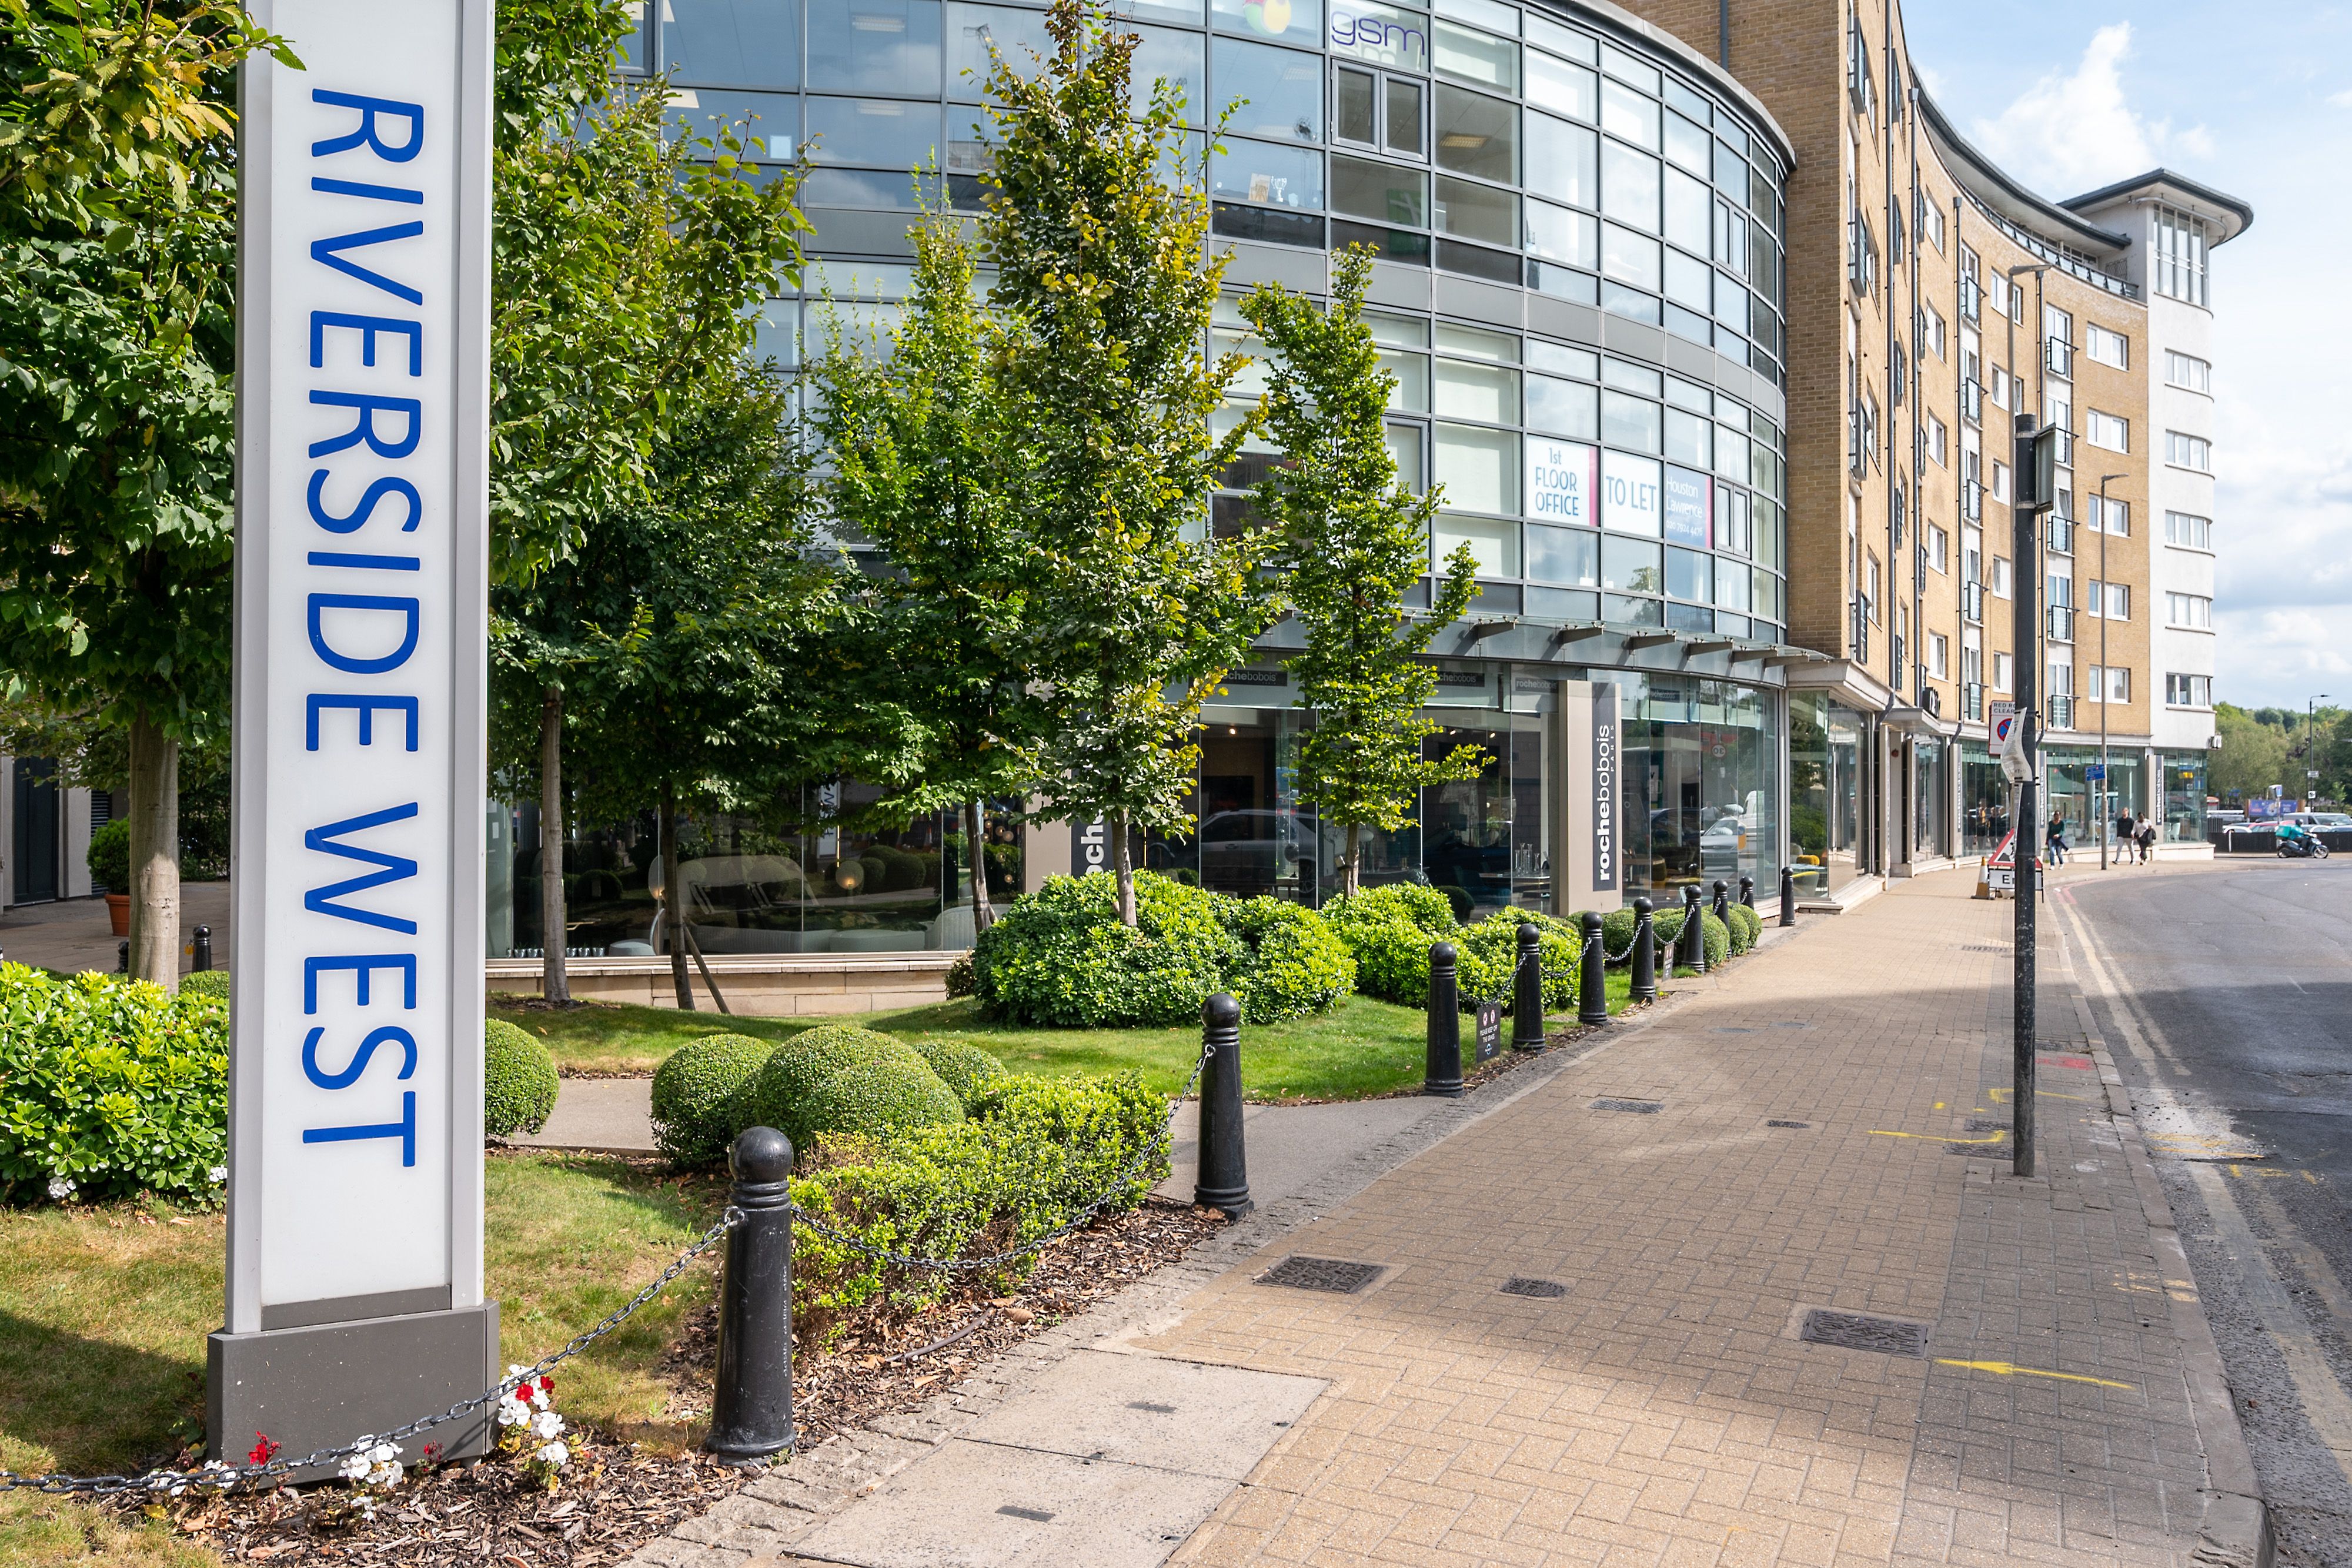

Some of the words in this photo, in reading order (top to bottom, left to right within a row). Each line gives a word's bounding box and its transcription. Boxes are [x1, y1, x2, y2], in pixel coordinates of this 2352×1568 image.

[1331, 11, 1425, 56] gsm
[306, 88, 423, 752] RIVERSIDE
[1549, 447, 1562, 465] 1st
[1535, 466, 1577, 492] FLOOR
[1666, 475, 1698, 499] Houston
[1535, 492, 1579, 516] OFFICE
[1606, 475, 1626, 506] TO
[1631, 481, 1656, 511] LET
[1666, 494, 1703, 518] Lawrence
[1666, 520, 1676, 530] 020
[1596, 724, 1610, 881] rochebobois
[302, 801, 418, 1166] WEST
